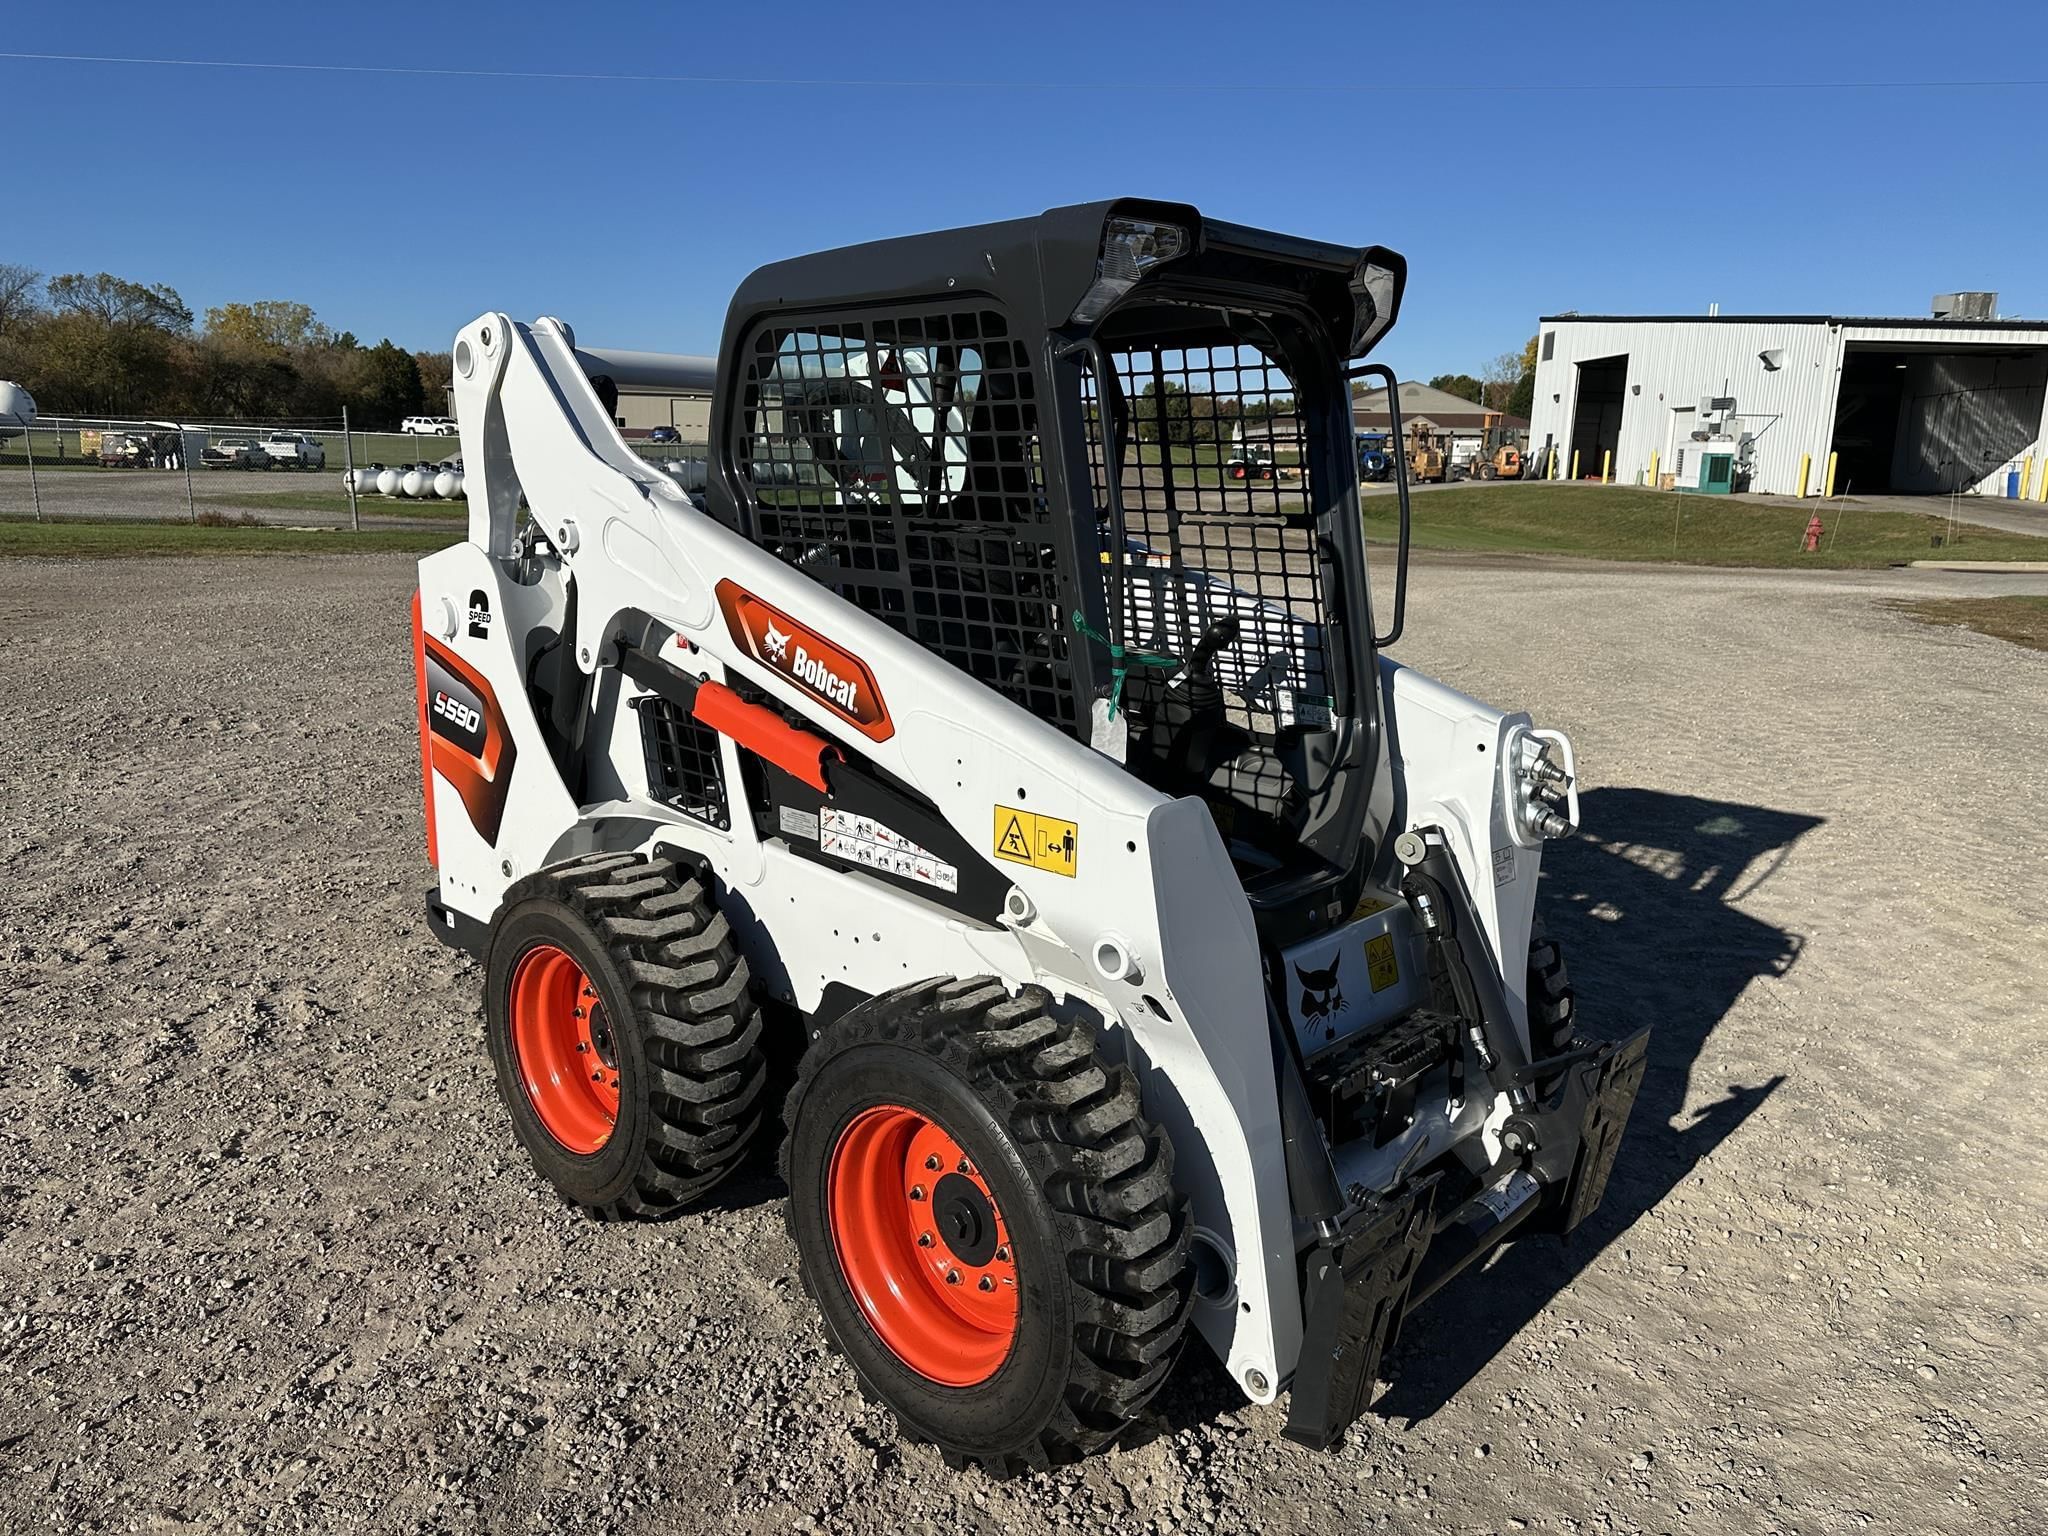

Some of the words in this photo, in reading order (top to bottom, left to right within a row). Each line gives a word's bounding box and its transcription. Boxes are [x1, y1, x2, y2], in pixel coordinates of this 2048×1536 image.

[468, 610, 492, 624] SPEED
[792, 645, 857, 711] Bobcat
[433, 690, 480, 734] S590
